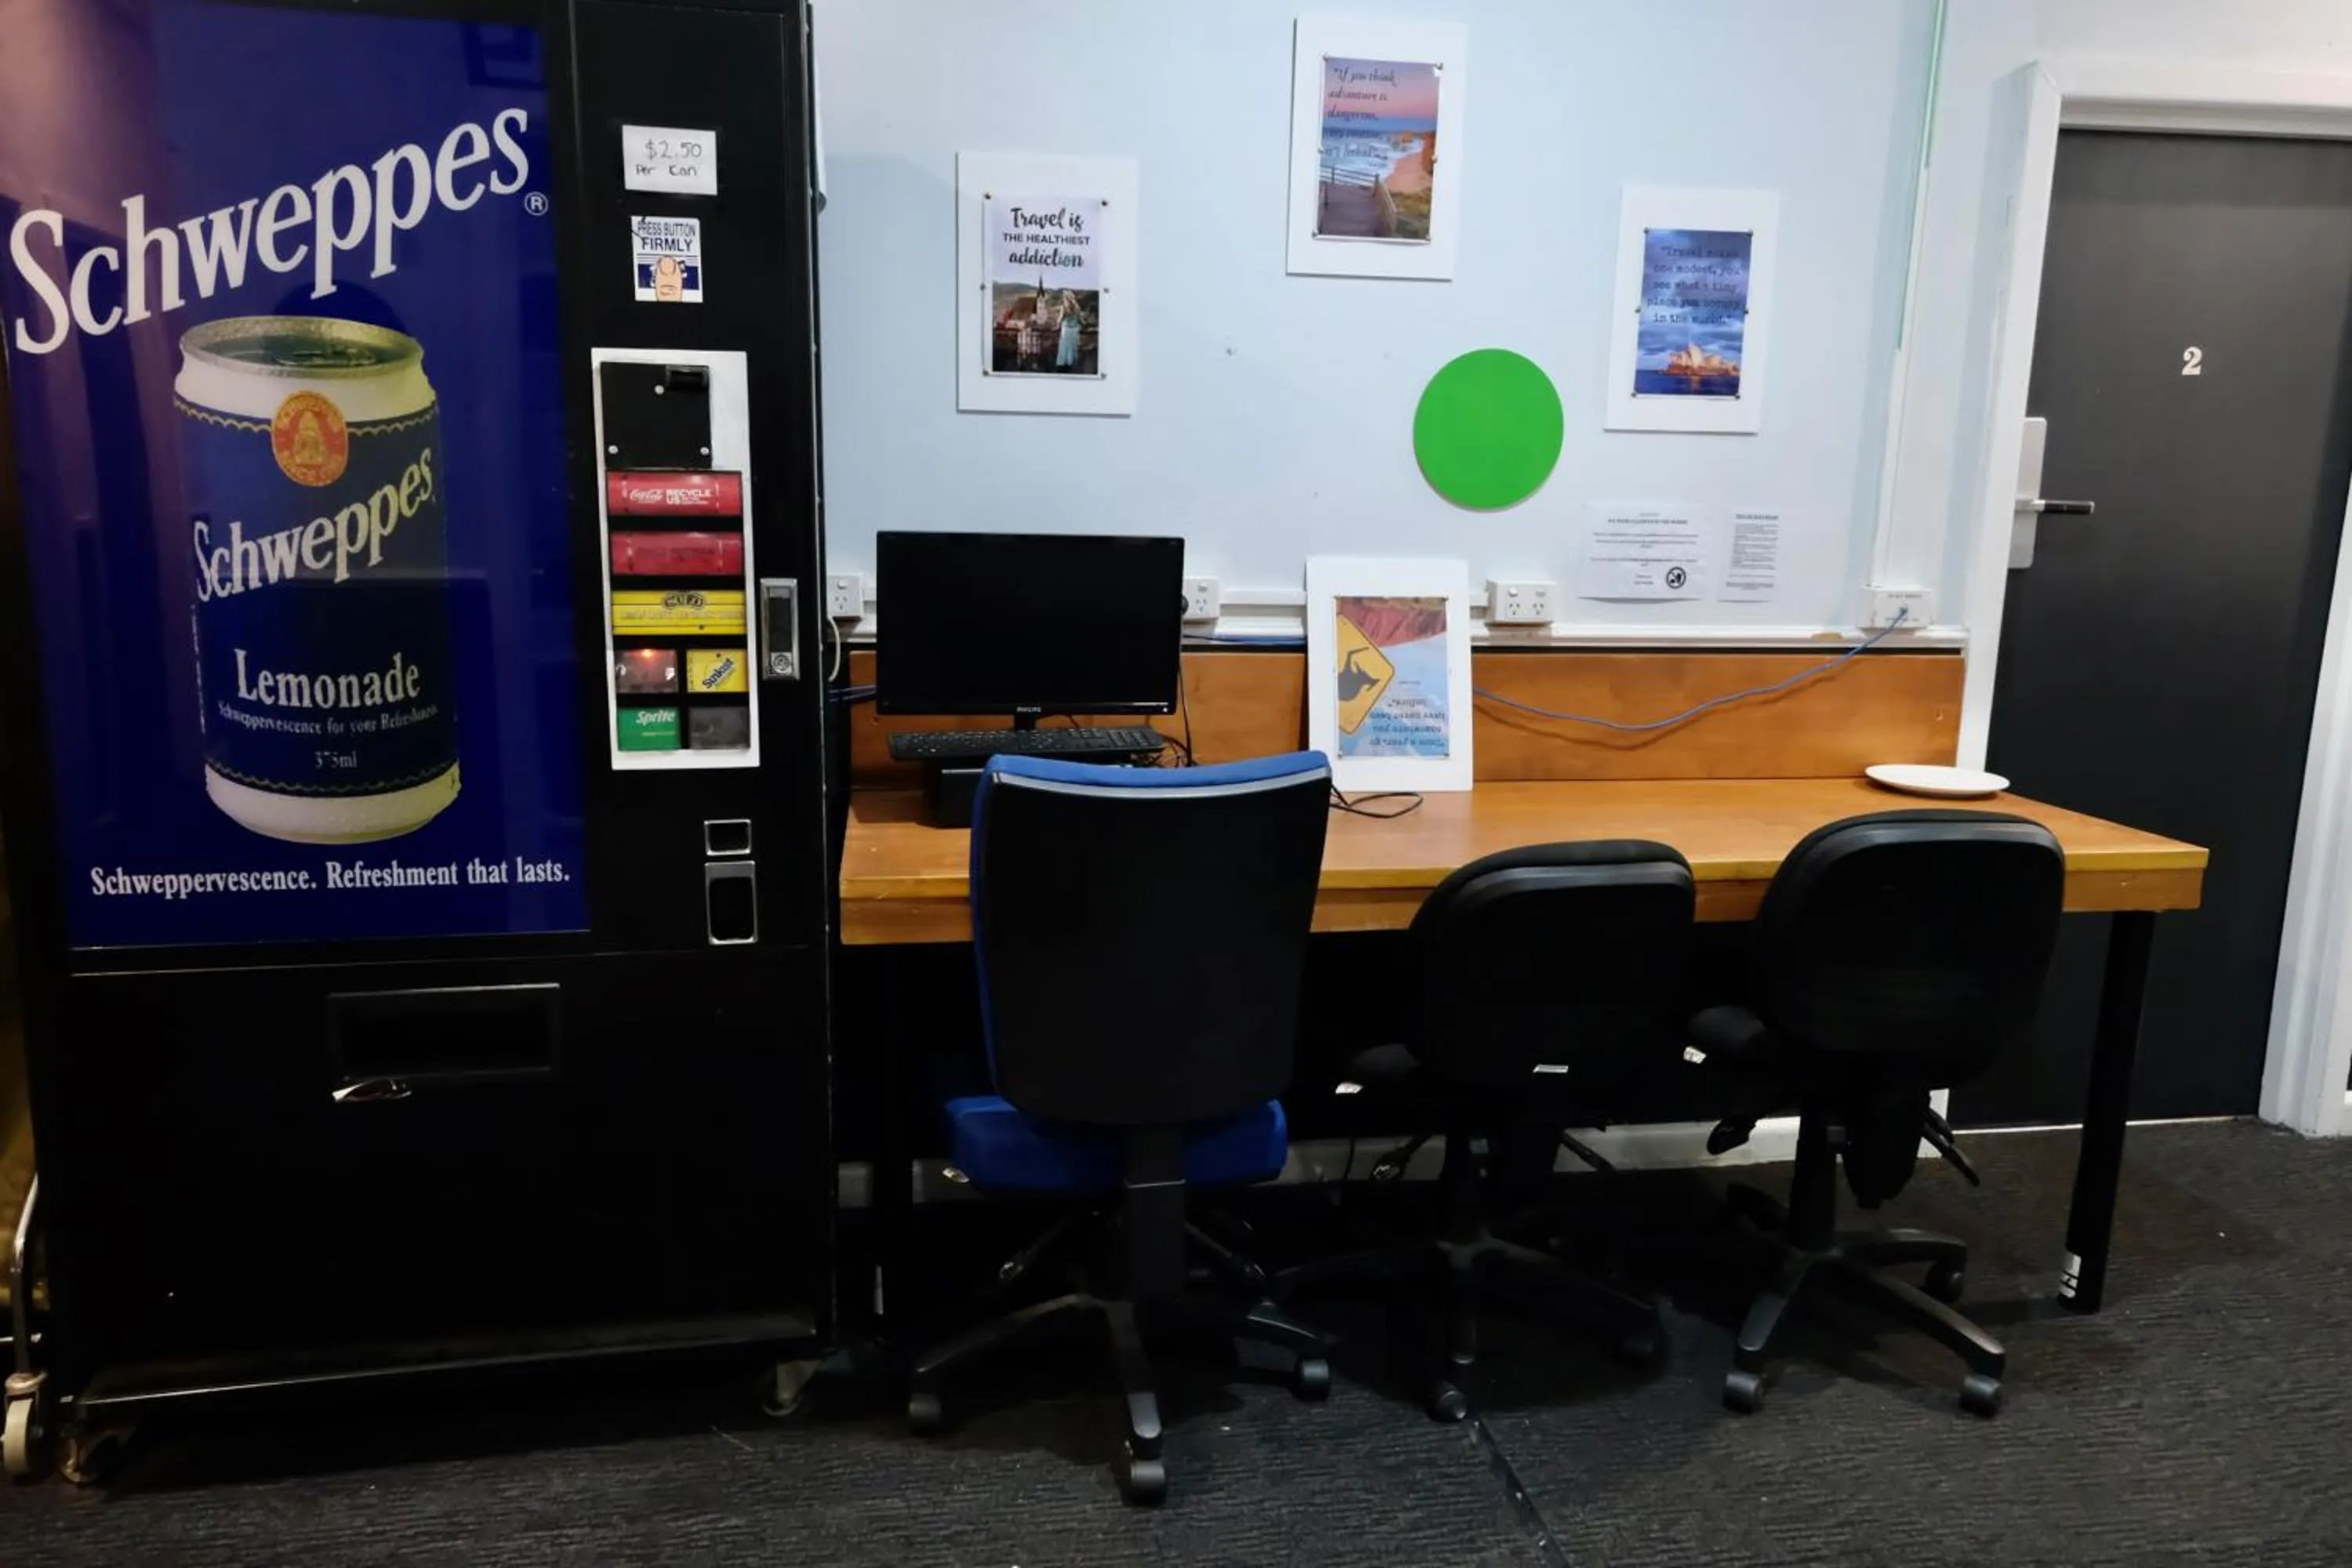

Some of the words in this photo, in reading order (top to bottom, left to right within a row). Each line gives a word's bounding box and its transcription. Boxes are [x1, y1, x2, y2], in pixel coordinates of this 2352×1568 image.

[644, 138, 702, 161] $2.50
[9, 108, 529, 354] Schweppes
[637, 222, 662, 236] PRESS
[664, 222, 696, 237] BUTTON
[1011, 207, 1066, 230] Travel
[1069, 212, 1084, 234] is
[641, 237, 693, 252] FIRMLY
[1003, 232, 1024, 243] THE
[1025, 233, 1091, 246] HEALTHIEST
[1008, 247, 1084, 268] addiction
[2182, 346, 2202, 376] 2
[192, 447, 434, 603] Schweppes
[234, 648, 422, 709] Lemonade
[327, 717, 345, 734] for
[635, 709, 676, 727] Sprite
[91, 866, 317, 898] Schweppervescence.
[326, 860, 459, 888] Refreshment
[466, 858, 508, 885] that
[516, 856, 571, 884] lasts.
